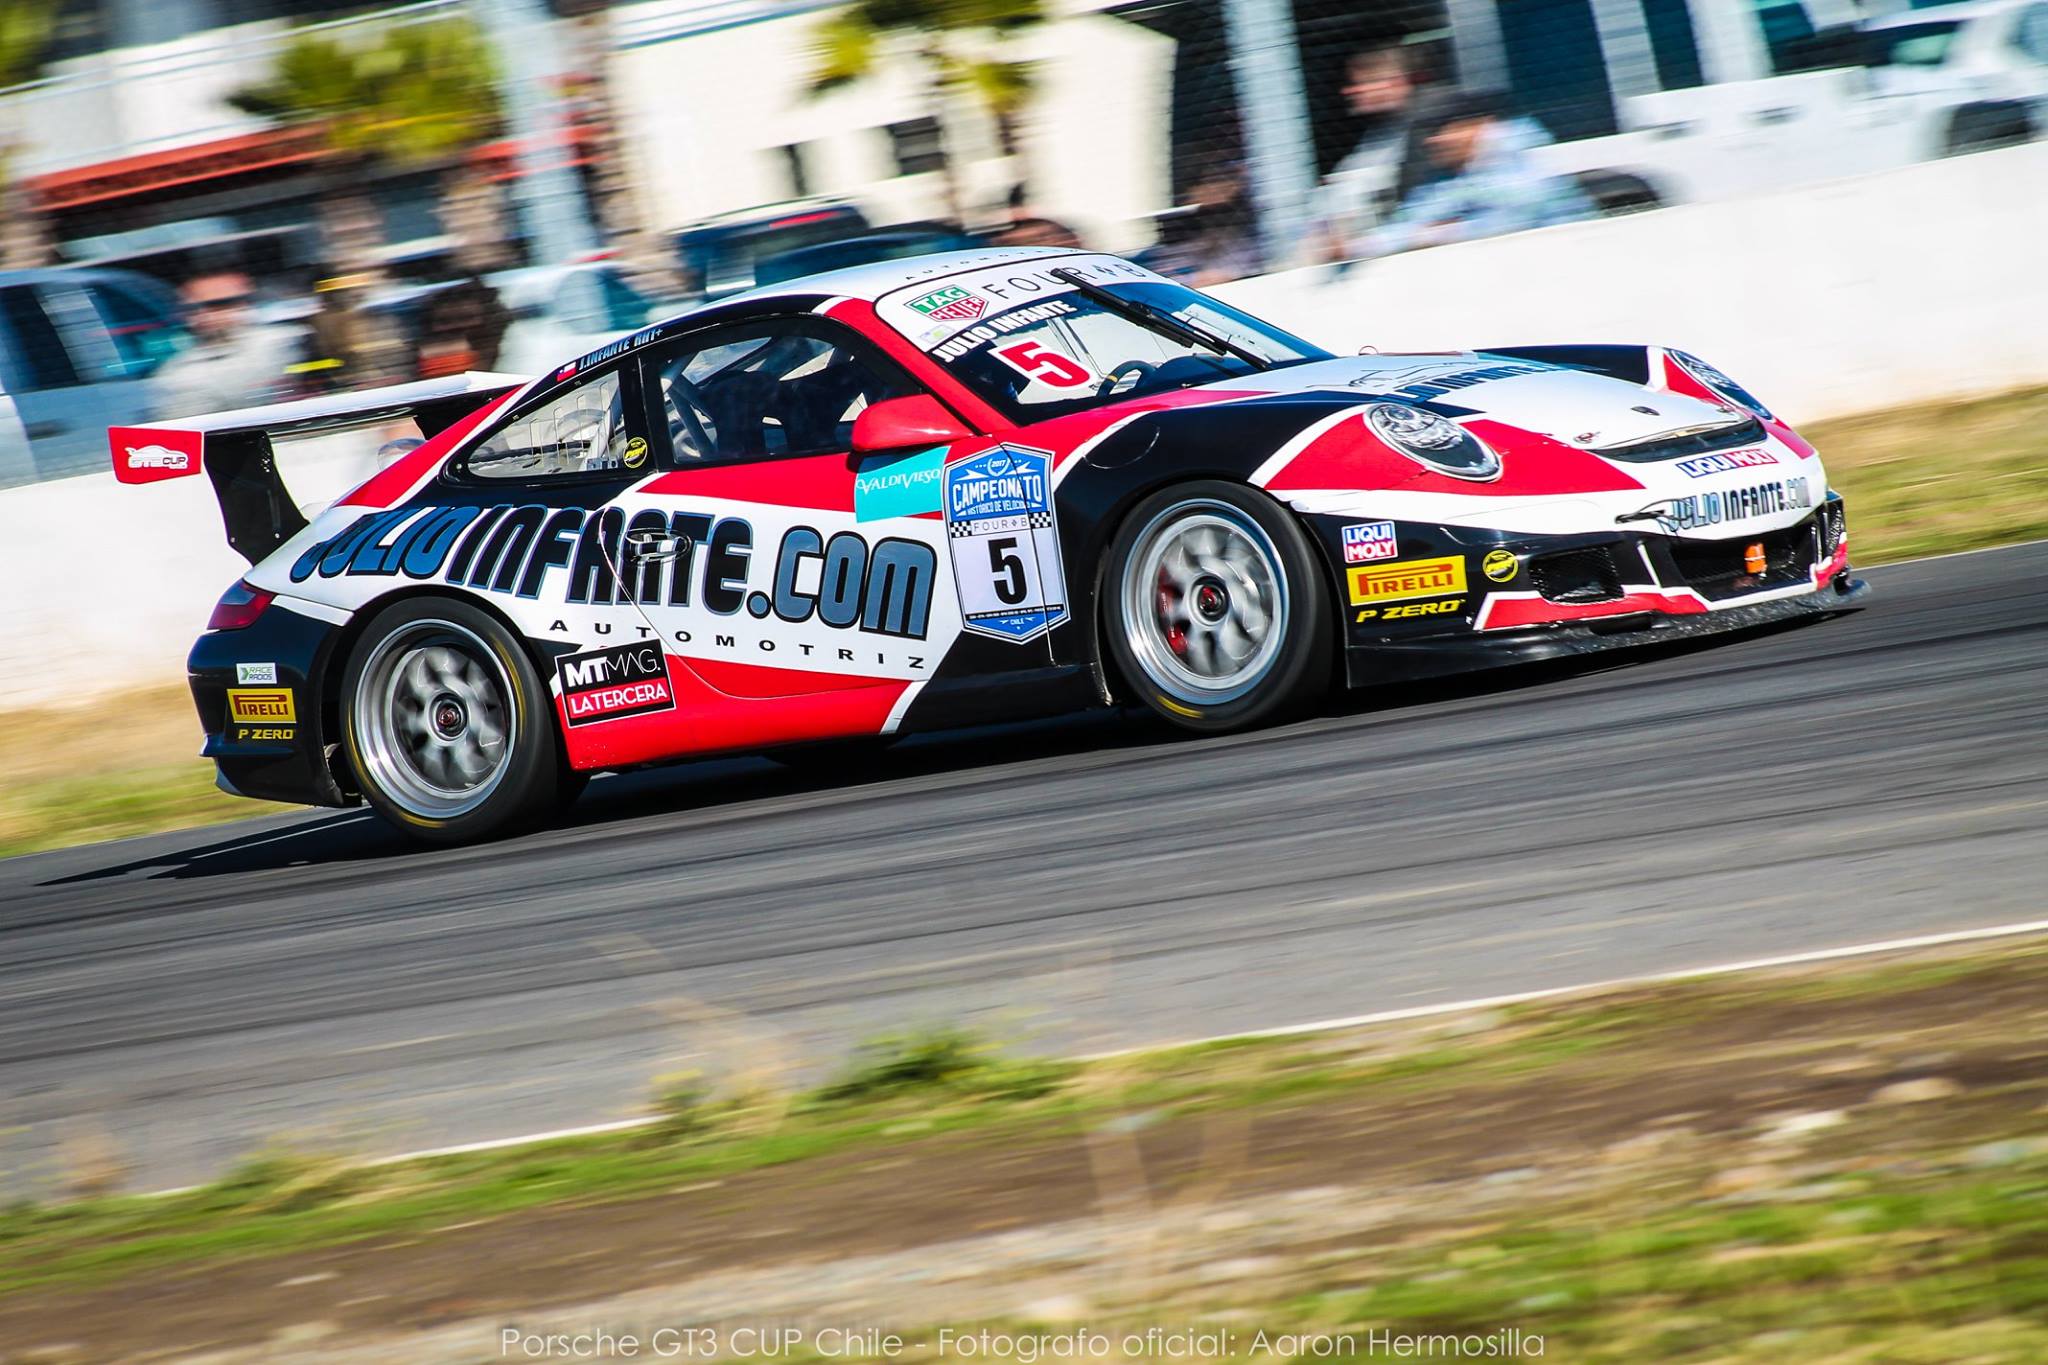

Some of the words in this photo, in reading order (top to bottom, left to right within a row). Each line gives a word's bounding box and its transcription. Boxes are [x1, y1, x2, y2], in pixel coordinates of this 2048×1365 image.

[914, 286, 967, 310] TAG
[929, 296, 985, 321] HEUER
[932, 326, 998, 363] JULIO
[988, 299, 1078, 333] INFANTE
[998, 341, 1091, 388] 5
[162, 456, 187, 465] CUP
[1678, 454, 1739, 477] LIQUI
[1727, 449, 1777, 467] MOLY
[856, 467, 942, 495] VALDIVIESO
[952, 474, 1043, 513] CAMPEONATO
[973, 518, 1008, 532] FOUR
[1020, 517, 1028, 527] B
[1346, 525, 1393, 544] LIQUI
[1347, 540, 1396, 561] MOLY
[988, 536, 1028, 605] 5
[1356, 563, 1455, 597] PIRELLI
[1355, 609, 1378, 623] P
[1381, 600, 1461, 620] ZERO
[232, 694, 289, 716] PIRELLI
[238, 728, 249, 740] P
[251, 728, 295, 740] ZERO
